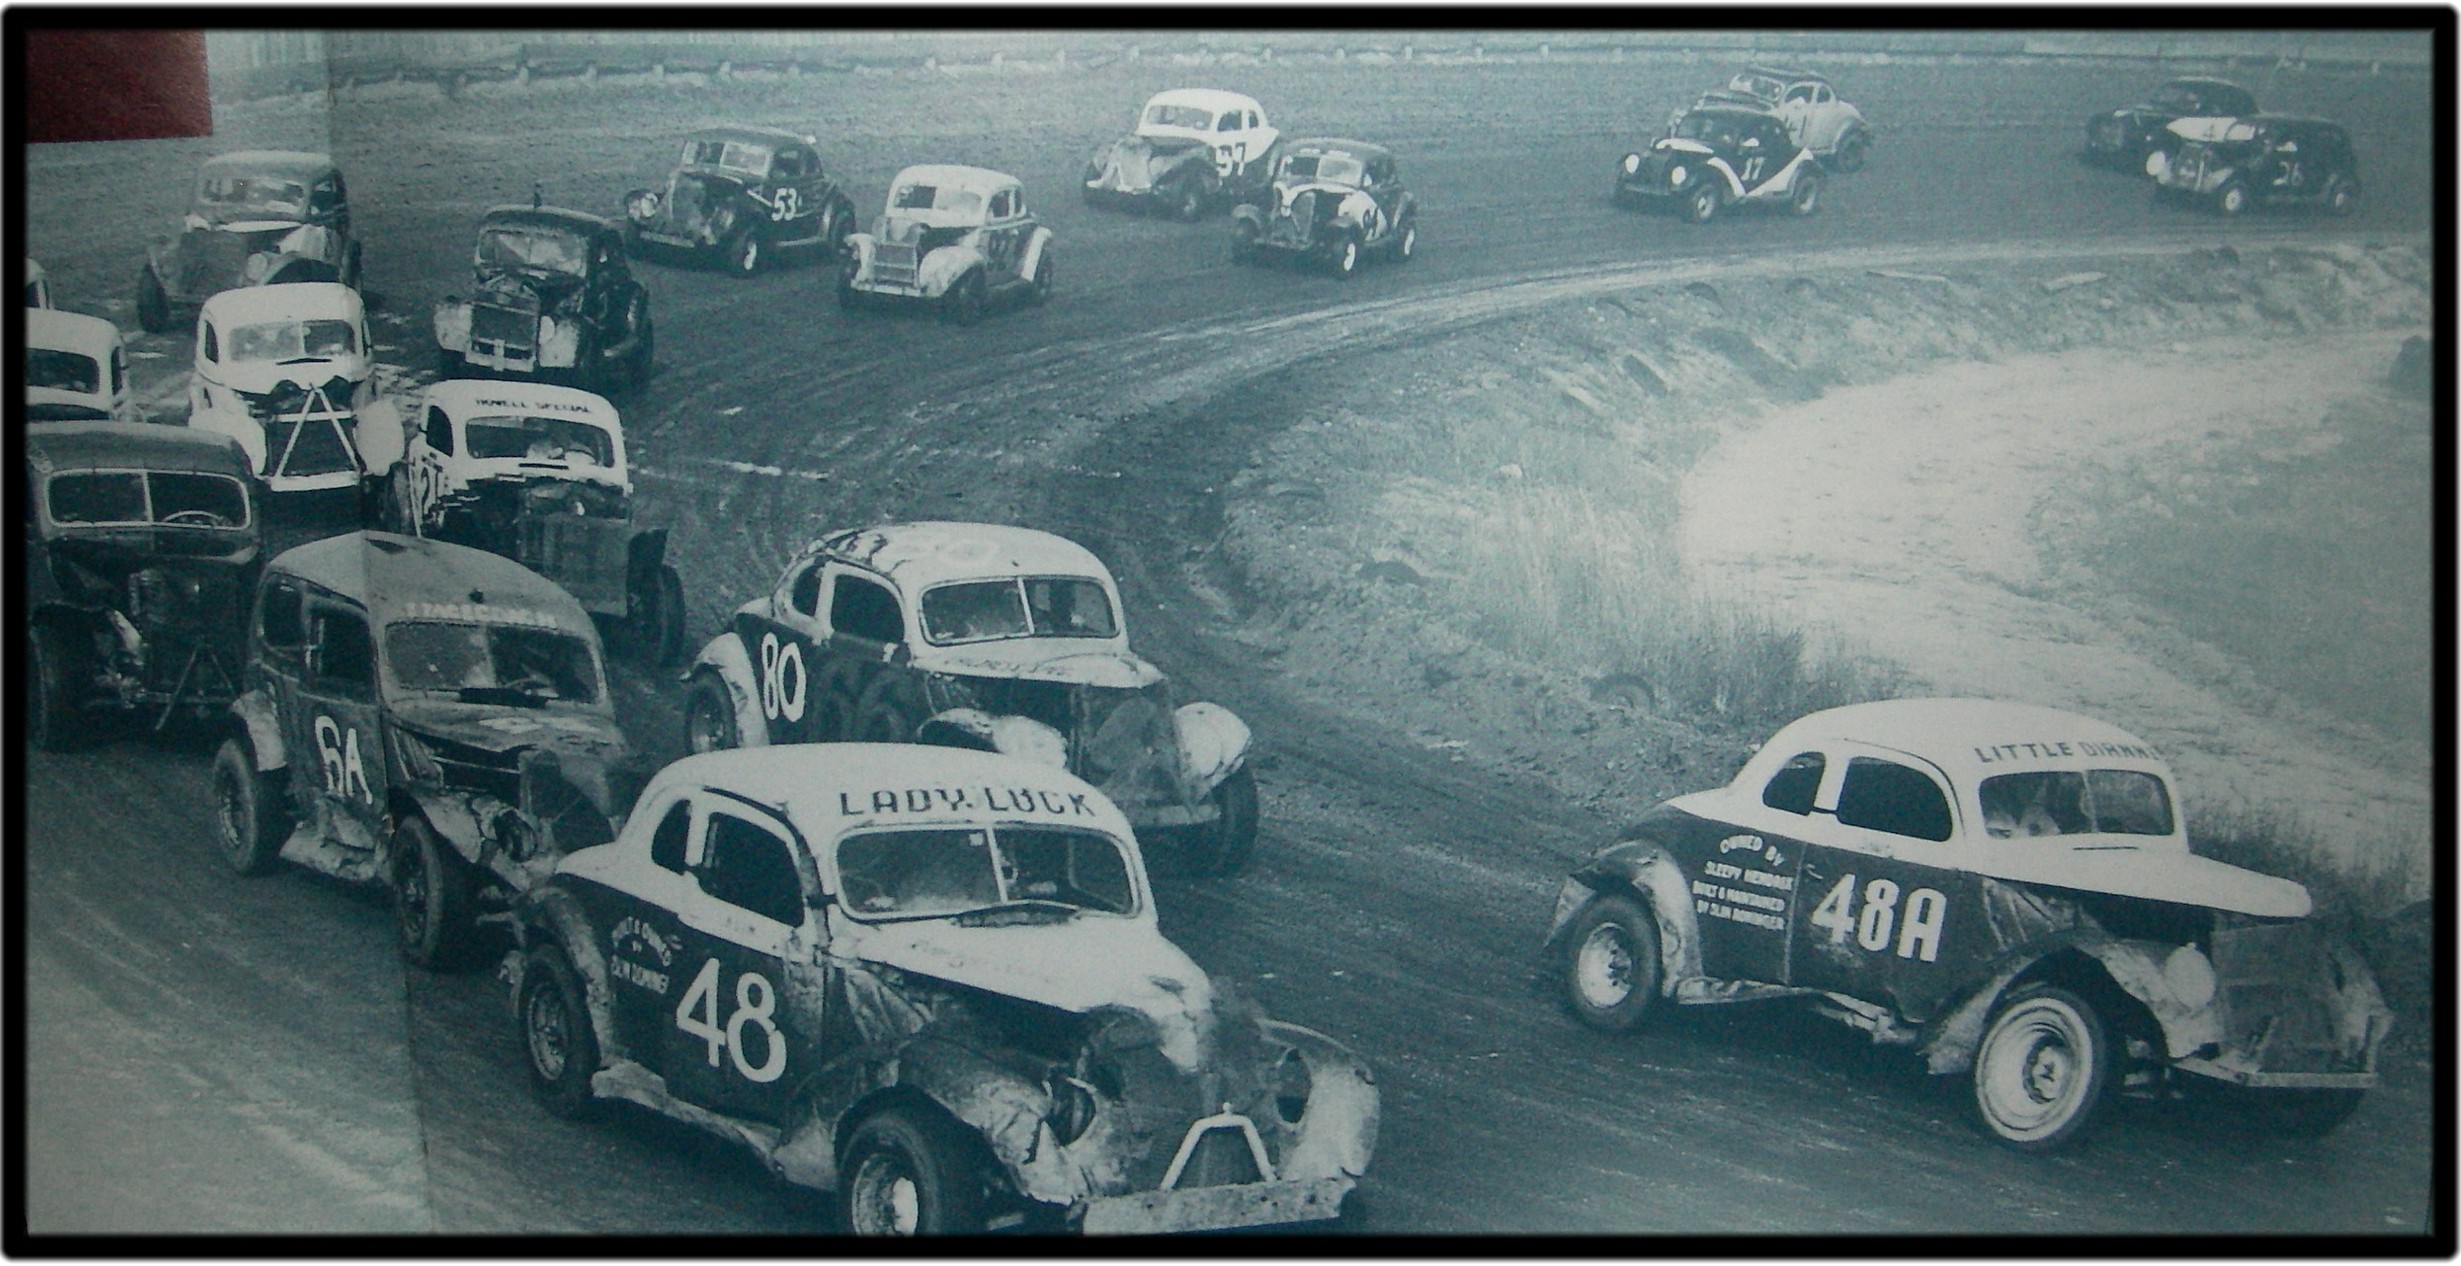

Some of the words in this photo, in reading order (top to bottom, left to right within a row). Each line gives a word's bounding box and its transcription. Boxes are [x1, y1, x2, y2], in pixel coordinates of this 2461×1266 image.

[1741, 157, 1766, 181] 17
[771, 187, 797, 222] 53
[761, 631, 807, 723] 80
[314, 714, 374, 806] 6A
[1974, 742, 2074, 763] LITTLE
[984, 787, 1096, 817] LUCK
[1720, 835, 1763, 854] OWNED
[1765, 845, 1786, 867] BY
[1810, 873, 1948, 963] 48A
[676, 957, 787, 1083] 48
